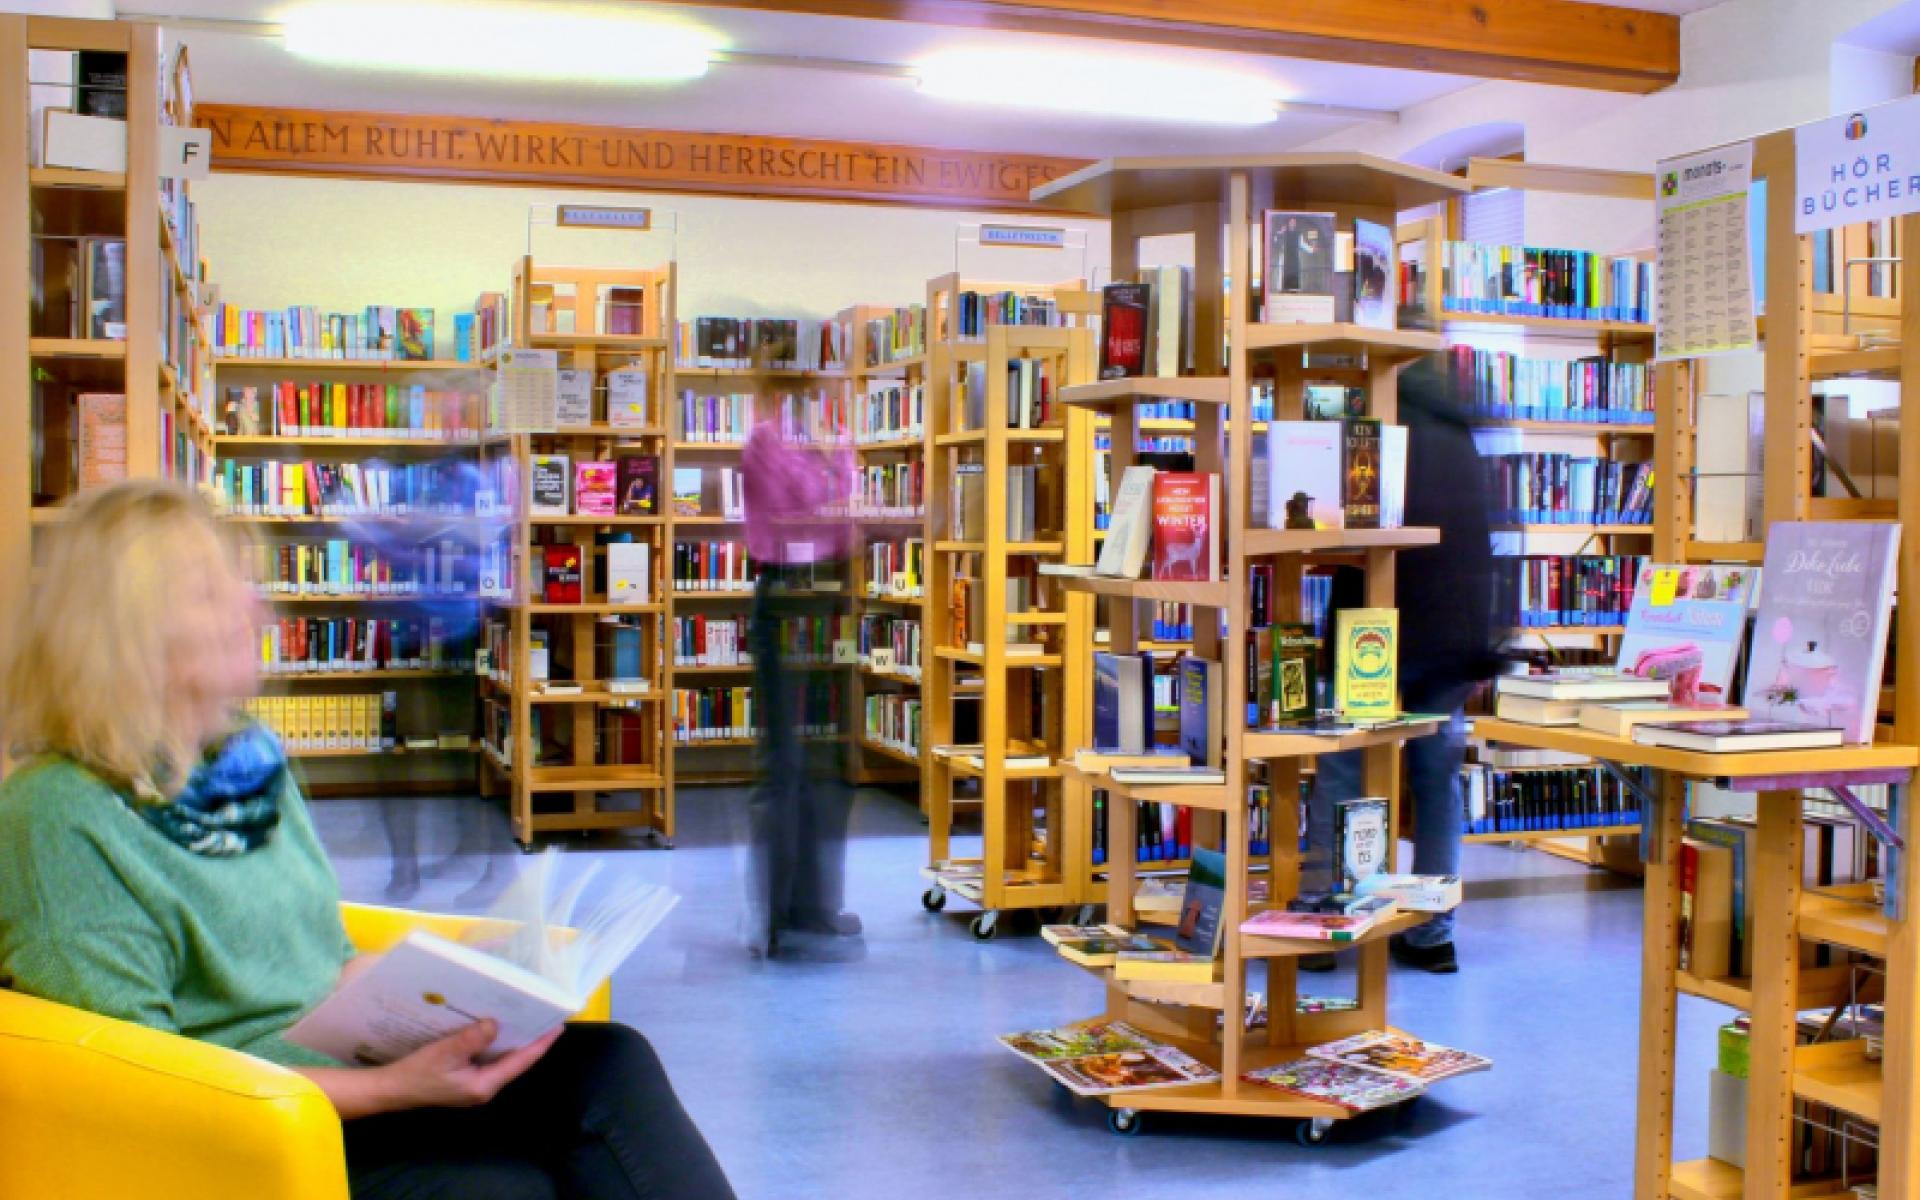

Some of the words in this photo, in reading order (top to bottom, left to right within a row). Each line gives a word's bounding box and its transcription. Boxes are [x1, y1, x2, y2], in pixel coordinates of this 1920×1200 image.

[184, 142, 200, 164] F
[245, 120, 350, 154] ALLEM
[475, 132, 588, 167] WIRKT
[602, 138, 673, 170] UND
[690, 143, 860, 183] HERRSCHT
[873, 155, 926, 185] EIN
[1831, 153, 1890, 184] HÖR
[1803, 175, 1920, 215] BÜCHER
